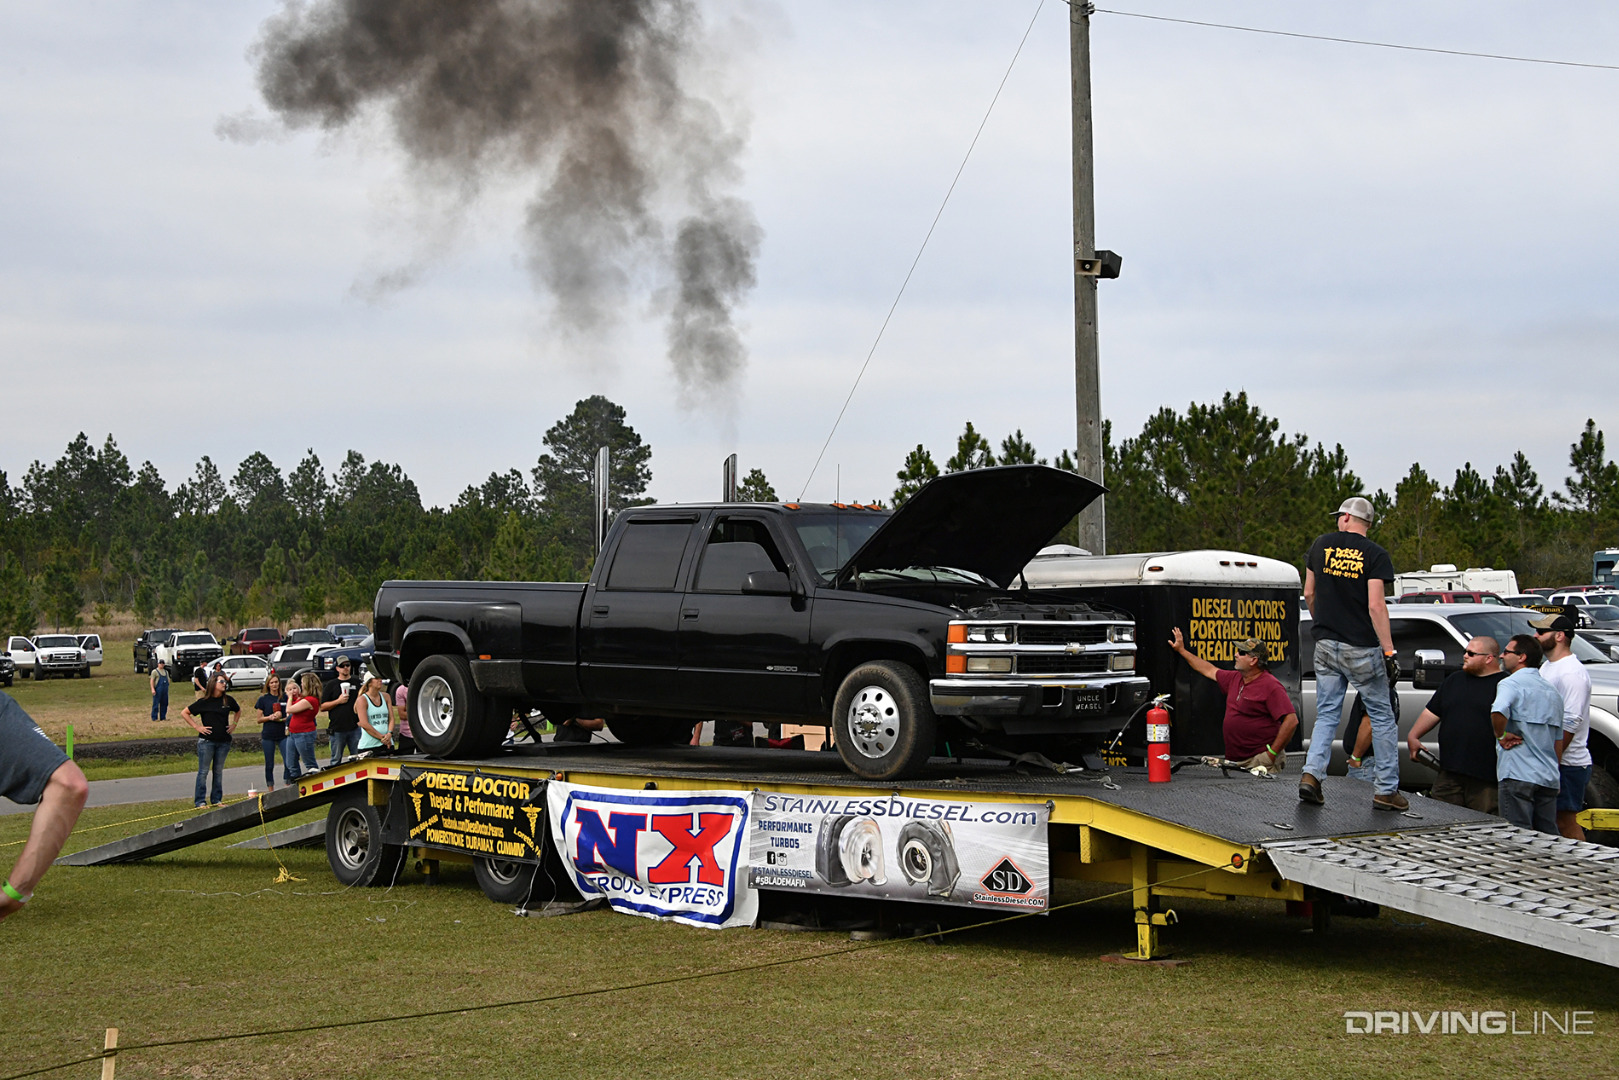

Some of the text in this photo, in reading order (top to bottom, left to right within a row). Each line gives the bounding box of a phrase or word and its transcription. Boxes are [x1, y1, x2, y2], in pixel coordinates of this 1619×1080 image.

[1335, 547, 1364, 561] DIESEL
[1330, 557, 1364, 575] DOCTOR
[1192, 598, 1286, 620] DIESEL DOCTOR'S
[1190, 619, 1281, 640] PORTABLE DYNO
[426, 772, 469, 792] DIESEL
[472, 776, 530, 800] DOCTOR
[428, 791, 514, 820] Repair & Performance
[764, 795, 1038, 826] STAINLESSDIESEL.com
[758, 820, 813, 834] PERFORMANCE
[465, 834, 495, 853] DURAMAX
[496, 840, 526, 857] CUMMINS
[770, 836, 800, 849] TURBOS
[752, 866, 814, 879] #STAINLESSDIESEL
[992, 869, 1023, 891] SD
[974, 893, 1045, 906] StainlessDiesel.COM
